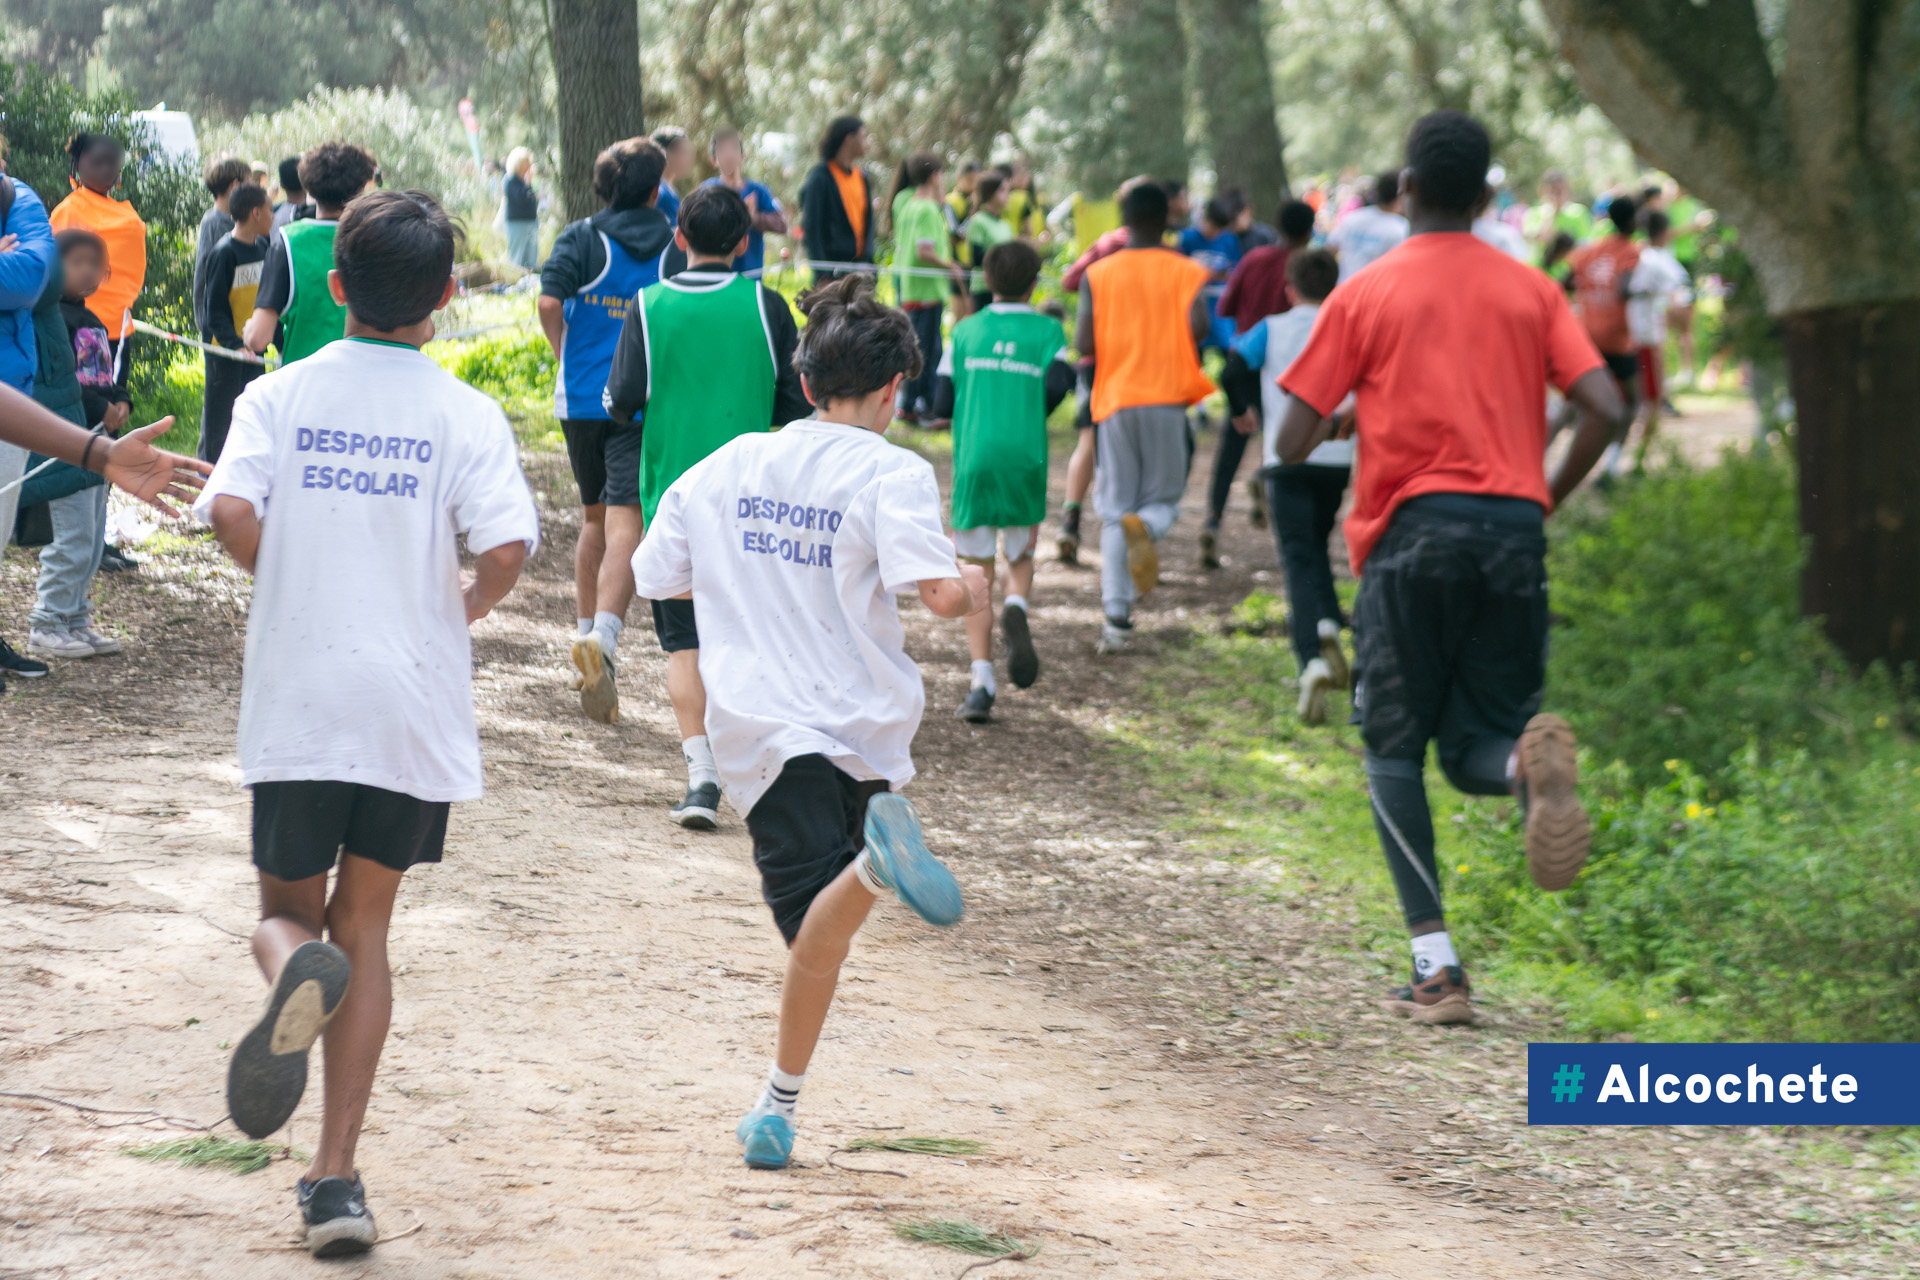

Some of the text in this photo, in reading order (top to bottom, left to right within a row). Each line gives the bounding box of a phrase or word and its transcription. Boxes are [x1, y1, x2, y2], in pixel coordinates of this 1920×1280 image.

[295, 427, 433, 463] DESPORTO
[301, 465, 419, 499] ESCOLAR
[737, 496, 843, 534] DESPORTO
[743, 530, 833, 568] ESCOLAR
